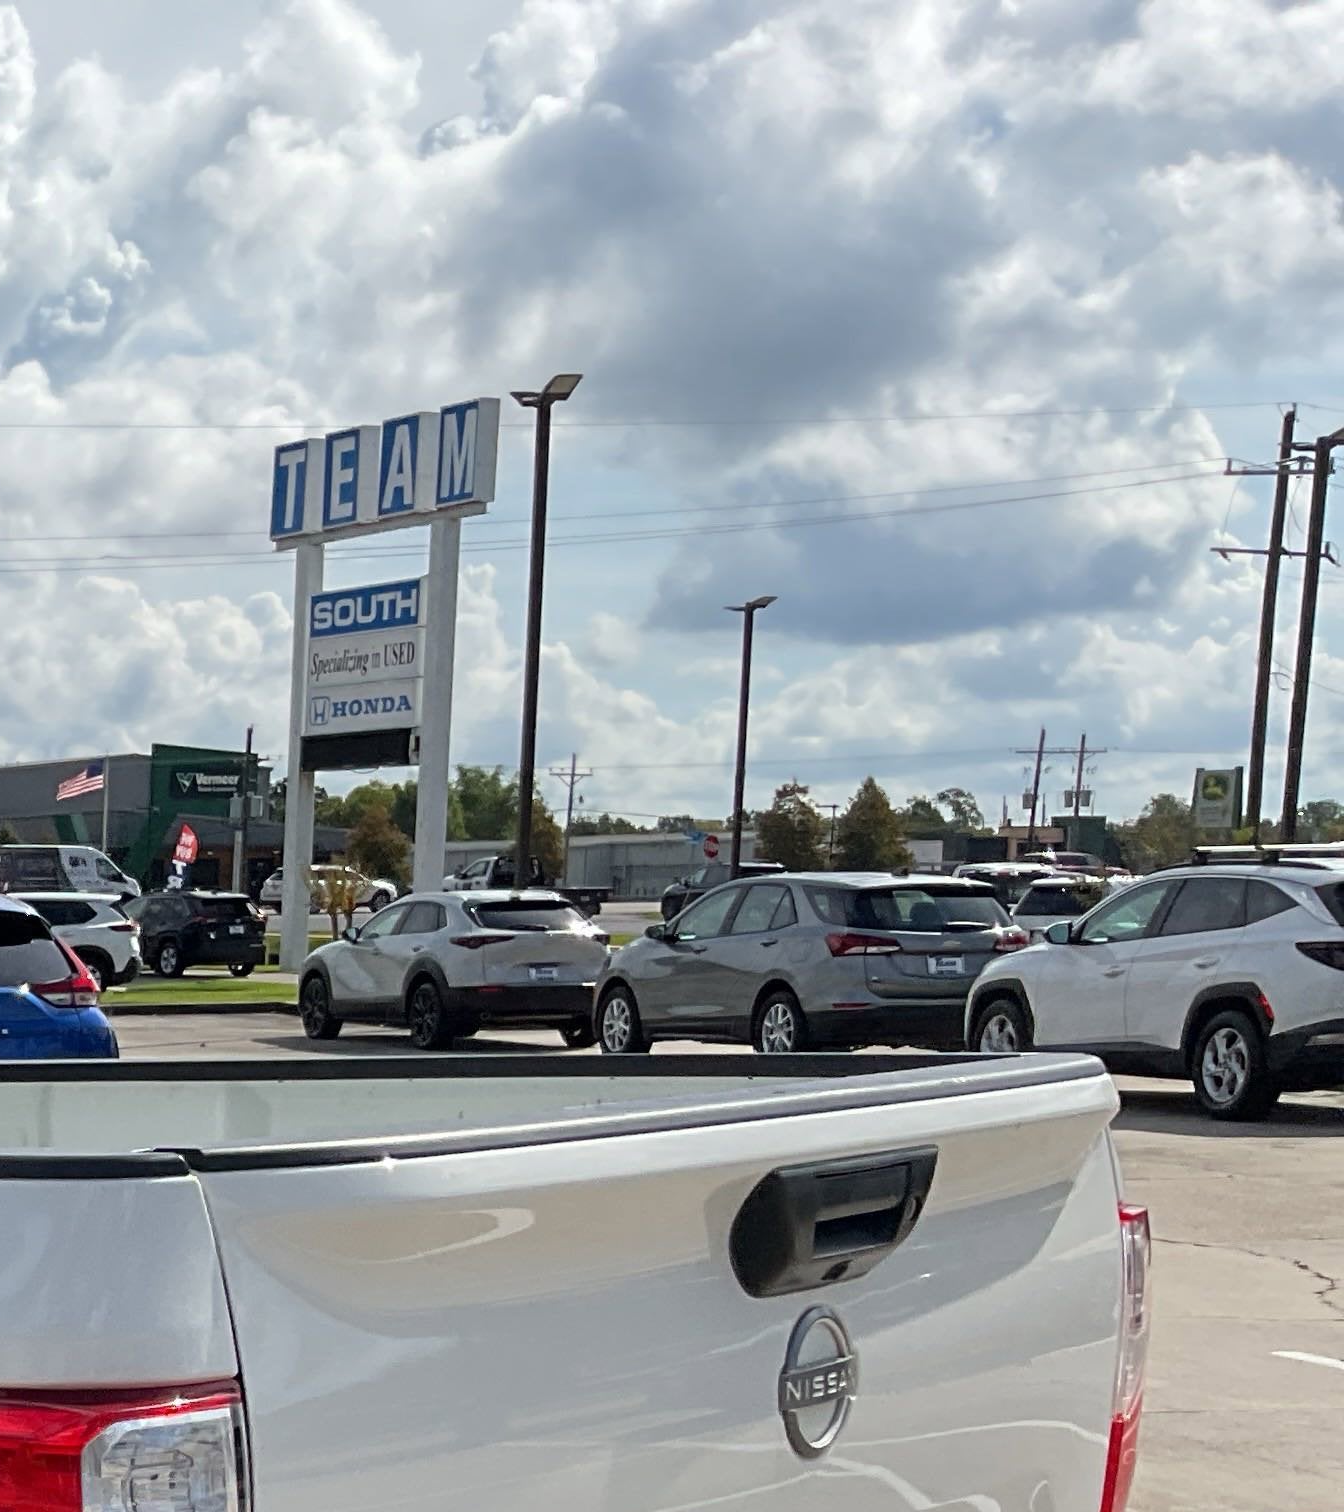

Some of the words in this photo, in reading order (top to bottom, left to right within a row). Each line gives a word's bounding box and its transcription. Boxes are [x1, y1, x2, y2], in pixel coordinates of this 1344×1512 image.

[278, 408, 479, 530] TEAM
[313, 588, 417, 630] SOUTH
[311, 648, 369, 682] Specializing
[371, 649, 381, 669] in
[384, 641, 416, 667] USED
[332, 695, 412, 718] HONDA
[195, 772, 240, 785] Vermeer
[785, 1367, 856, 1401] NISSAN
